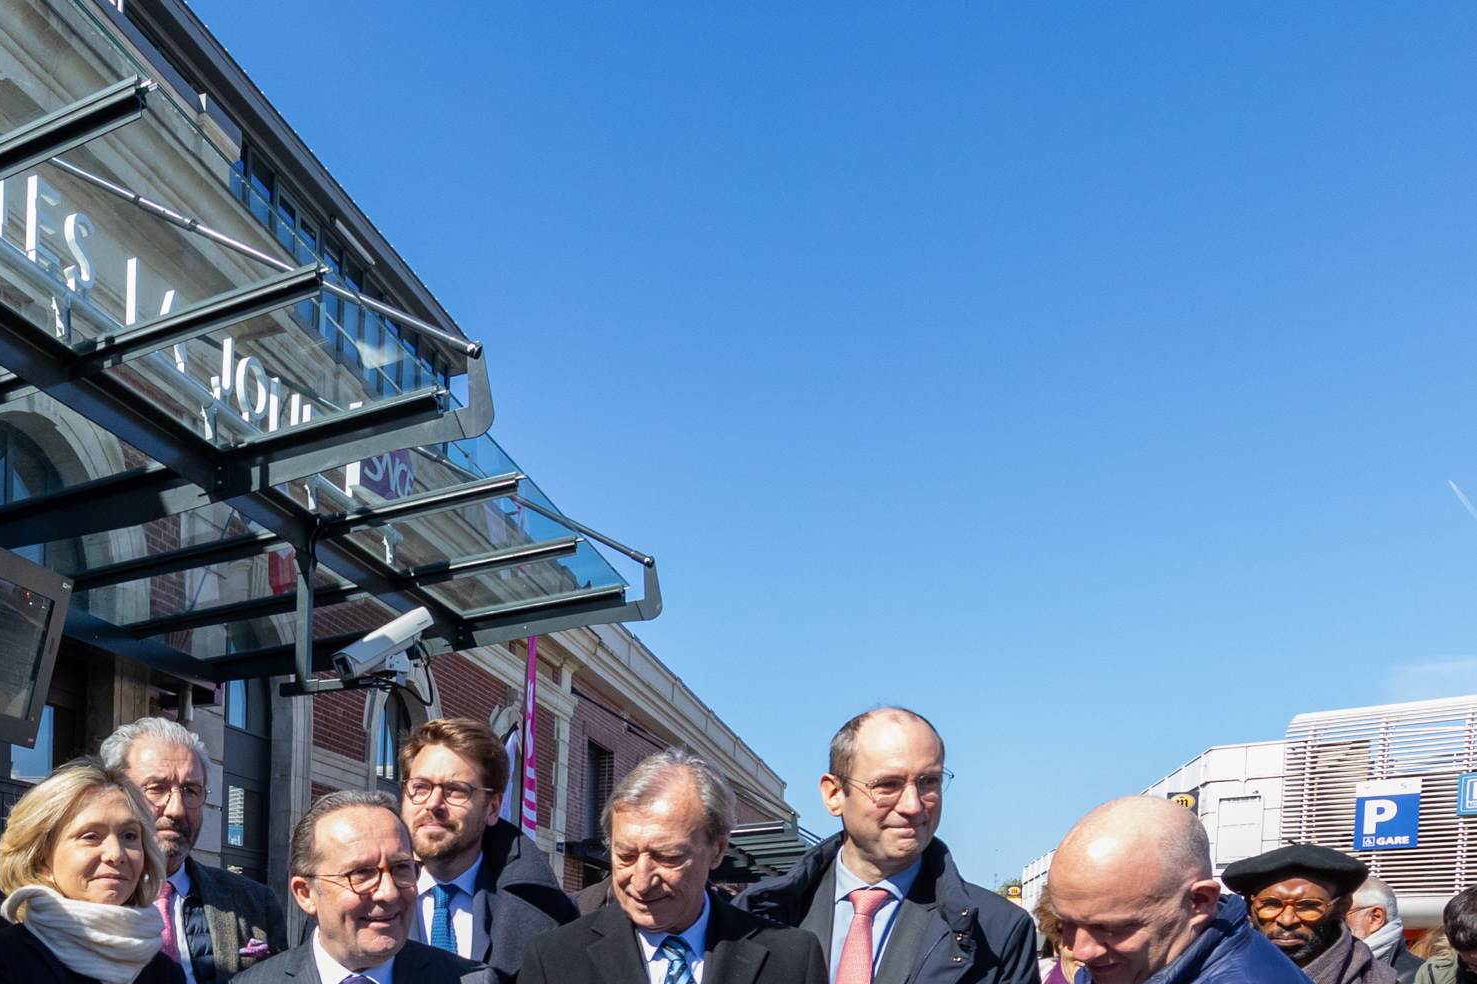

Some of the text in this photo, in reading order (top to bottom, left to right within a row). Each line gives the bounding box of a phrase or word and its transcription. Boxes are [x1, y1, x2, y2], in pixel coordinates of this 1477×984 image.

[364, 452, 415, 498] SNCF
[1363, 799, 1398, 835] P
[1376, 835, 1410, 846] GARE
